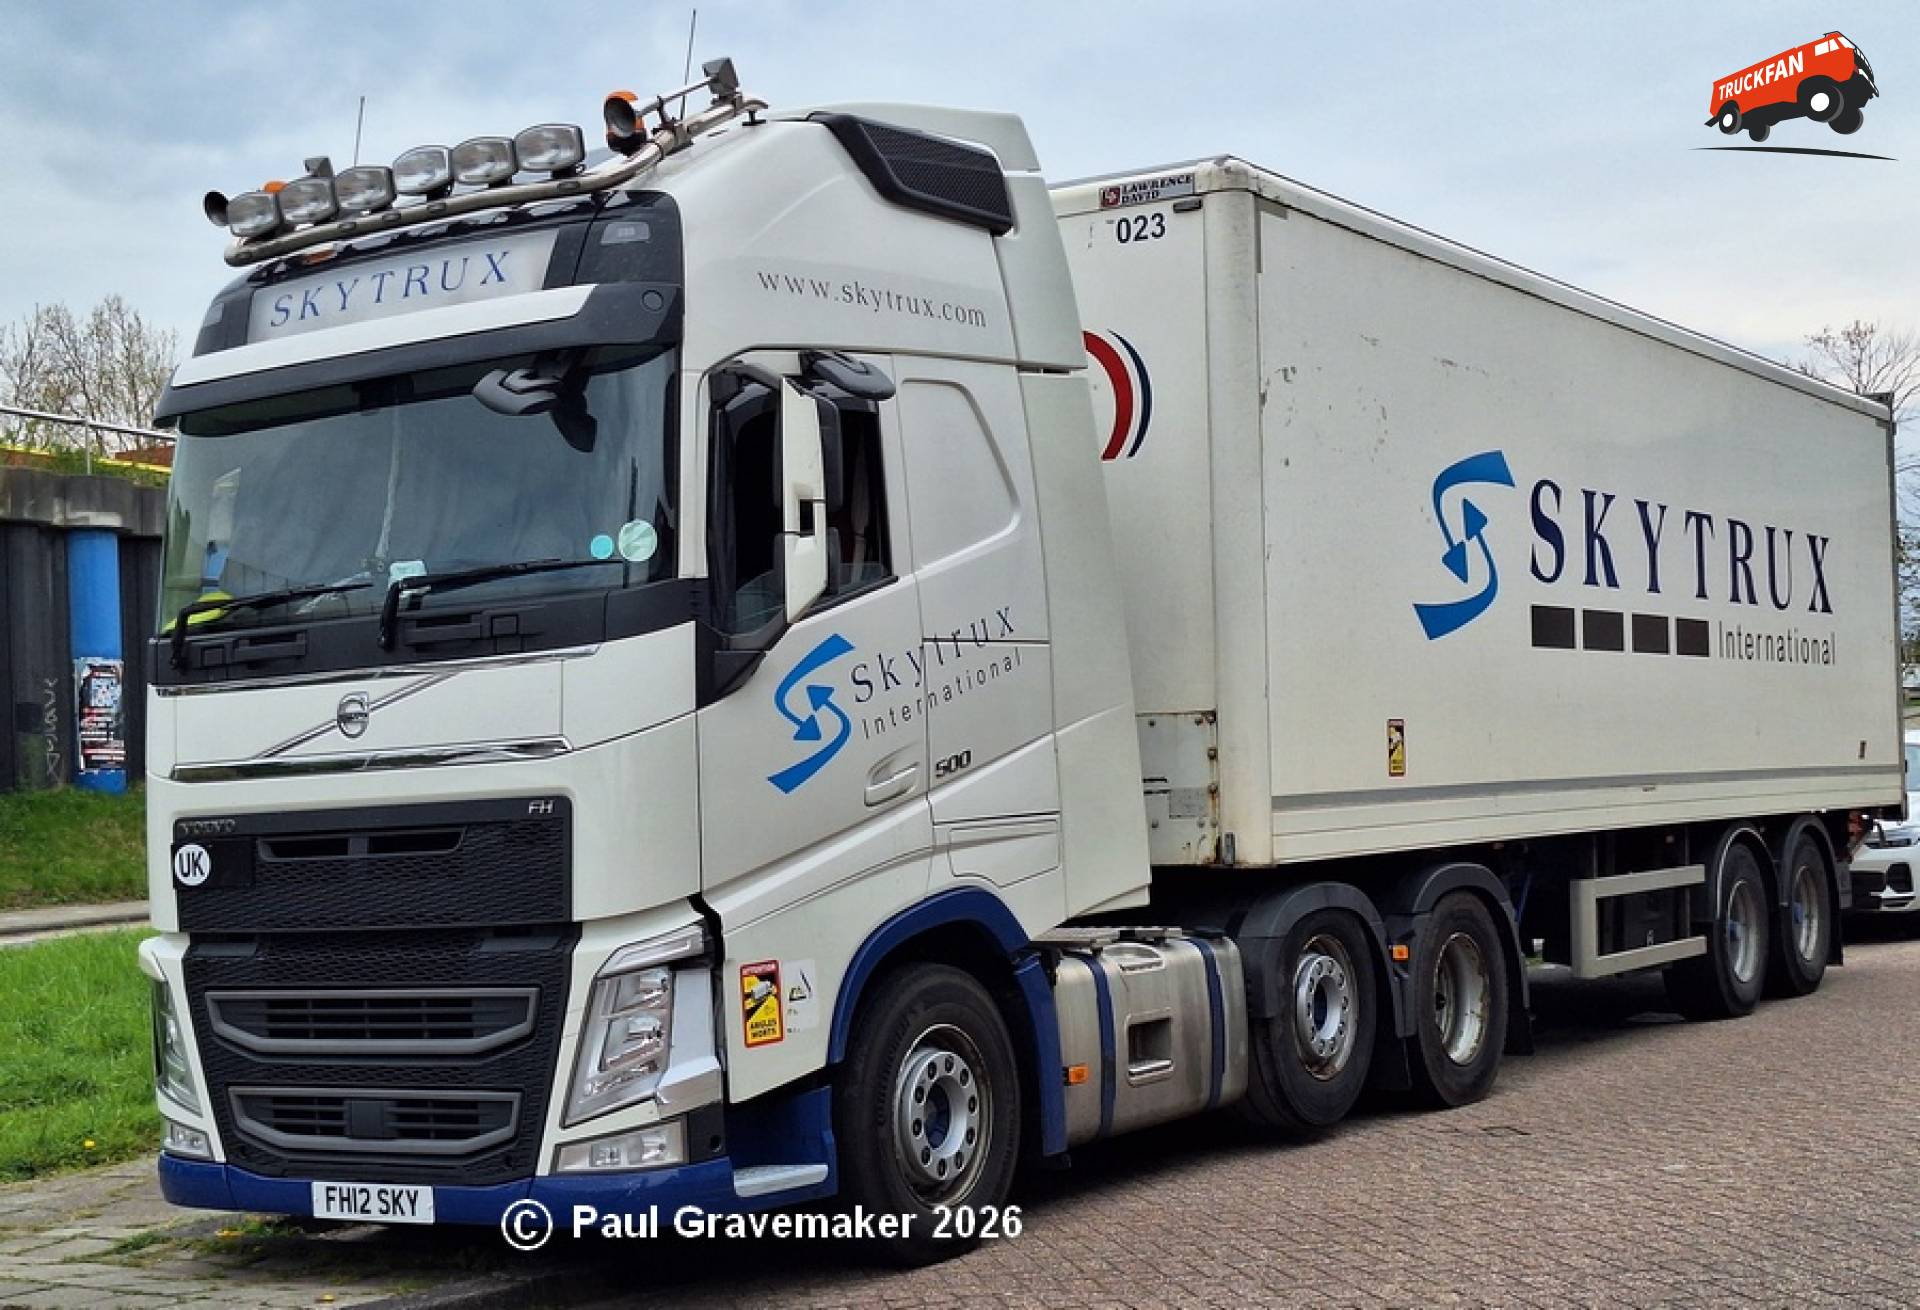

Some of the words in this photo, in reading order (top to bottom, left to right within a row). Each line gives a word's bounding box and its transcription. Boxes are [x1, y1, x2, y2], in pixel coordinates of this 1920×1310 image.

[1117, 213, 1166, 243] 023
[271, 251, 509, 327] SKYTRUX
[758, 271, 986, 328] www.skytrux.com
[1529, 479, 1833, 614] SKYTRUX
[851, 606, 1014, 703] Skytrux
[1718, 620, 1836, 666] International
[861, 647, 1022, 740] International
[936, 749, 972, 778] 500
[528, 800, 554, 815] FH
[178, 852, 205, 878] UK
[325, 1186, 371, 1215] FH12
[378, 1188, 419, 1217] SKY
